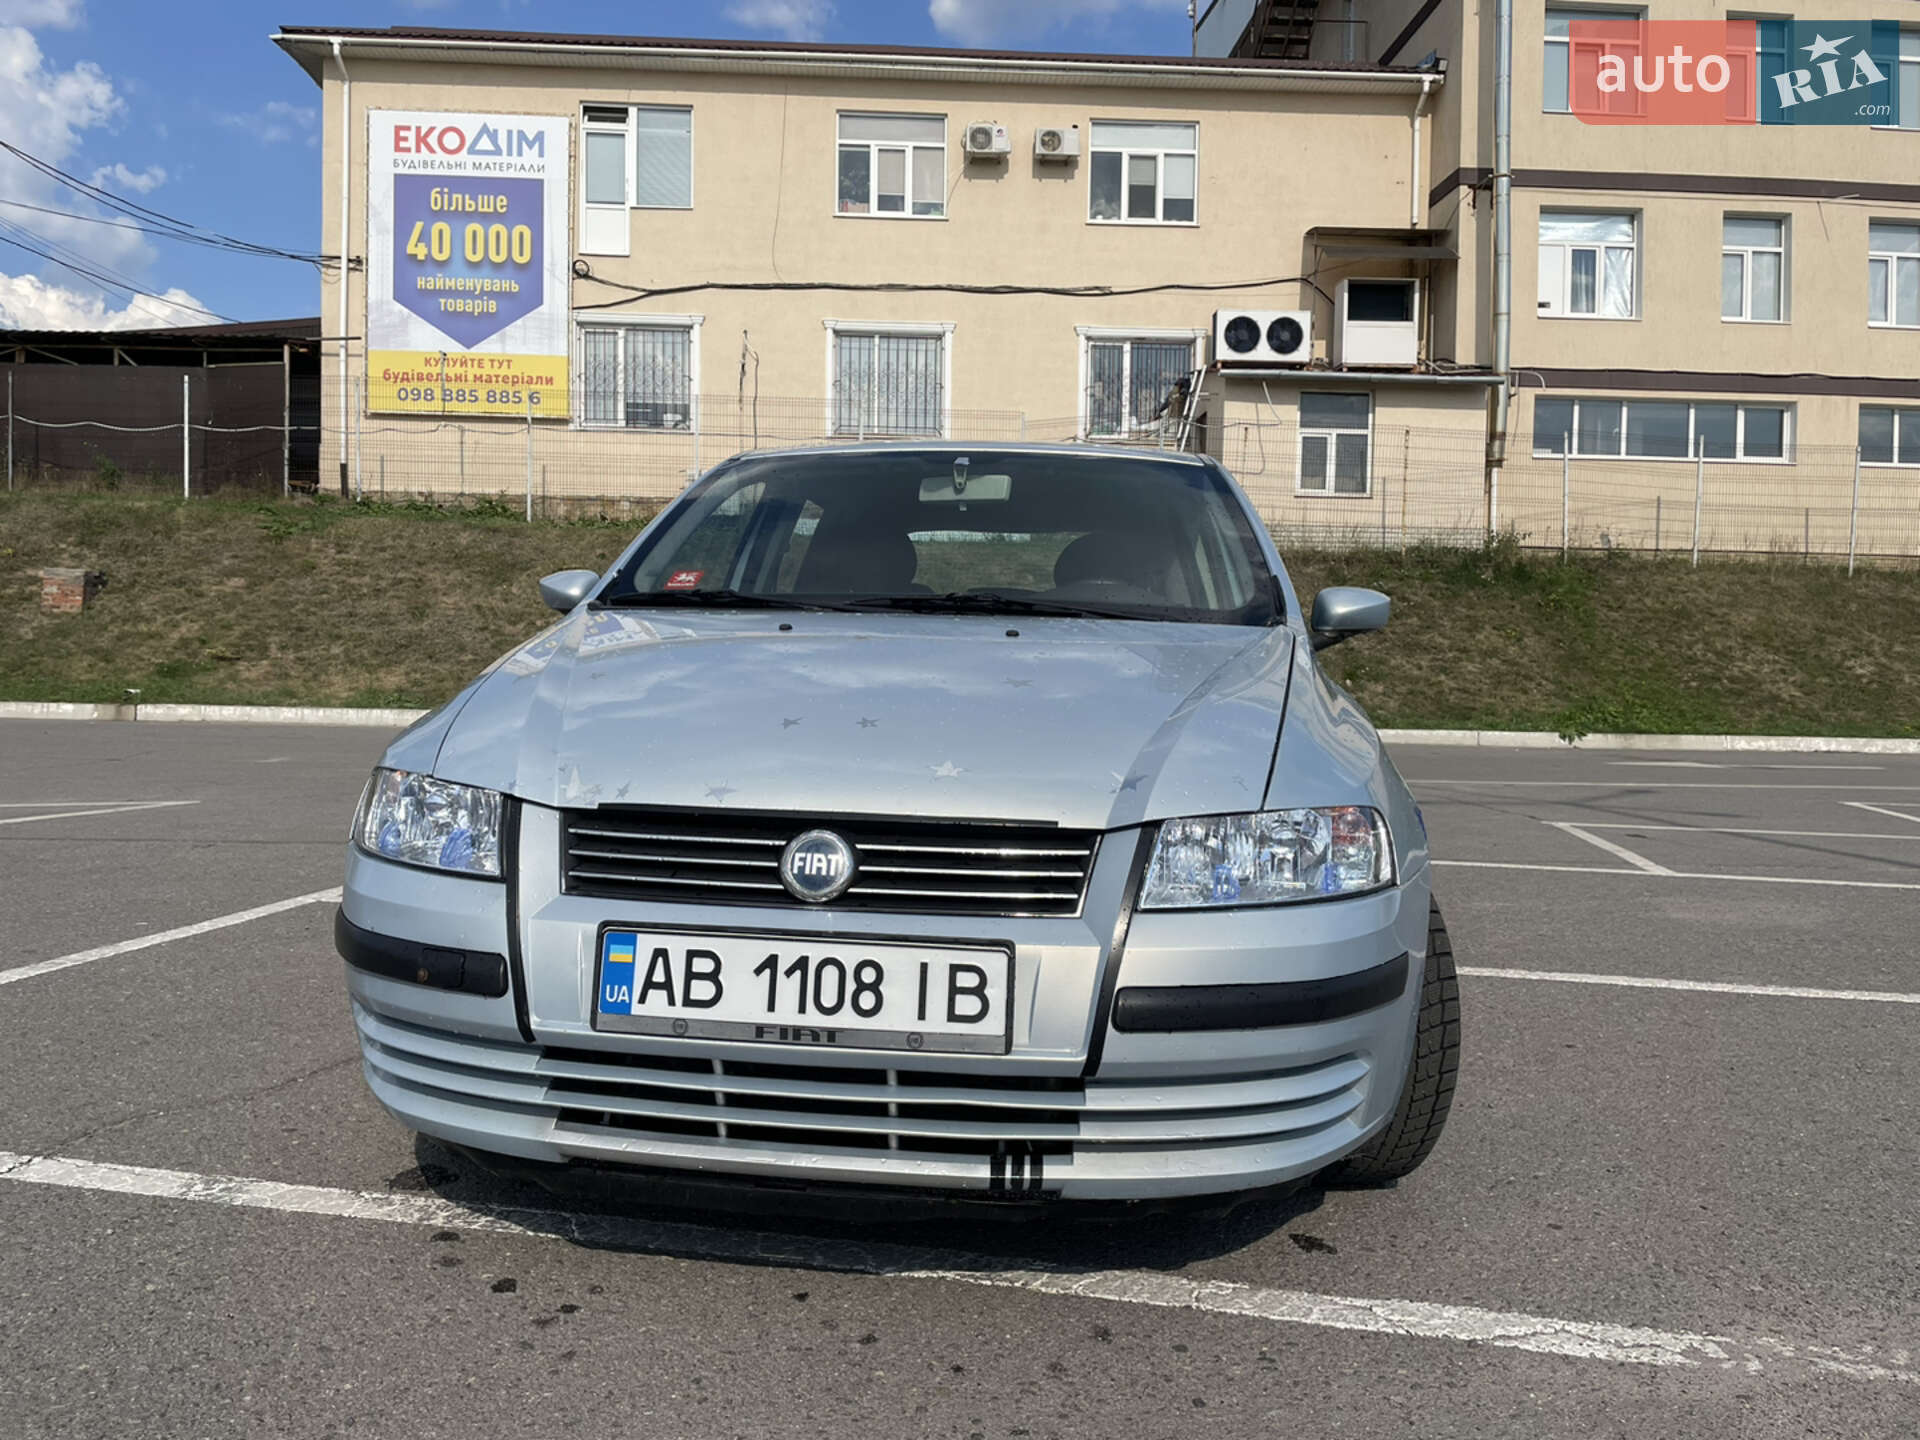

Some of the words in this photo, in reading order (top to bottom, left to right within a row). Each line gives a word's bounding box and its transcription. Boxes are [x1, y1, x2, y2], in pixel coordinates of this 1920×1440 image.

[393, 158, 467, 171] БУДІВЕЛЬНІ
[472, 161, 545, 174] МАТЕРІАЛИ
[430, 187, 508, 214] більше
[406, 221, 451, 261] 40
[464, 222, 532, 264] 000
[417, 274, 520, 293] найменувань
[439, 296, 497, 315] товарів
[489, 358, 513, 370] ТУТ
[383, 368, 468, 384] будівельні
[473, 372, 554, 387] матеріали
[397, 387, 435, 401] 098
[442, 388, 479, 402] 885
[486, 389, 523, 404] 885
[792, 851, 842, 876] FIAT
[605, 984, 630, 1004] UA
[637, 947, 724, 1009] AB
[753, 953, 885, 1018] 1108
[917, 961, 990, 1024] IB
